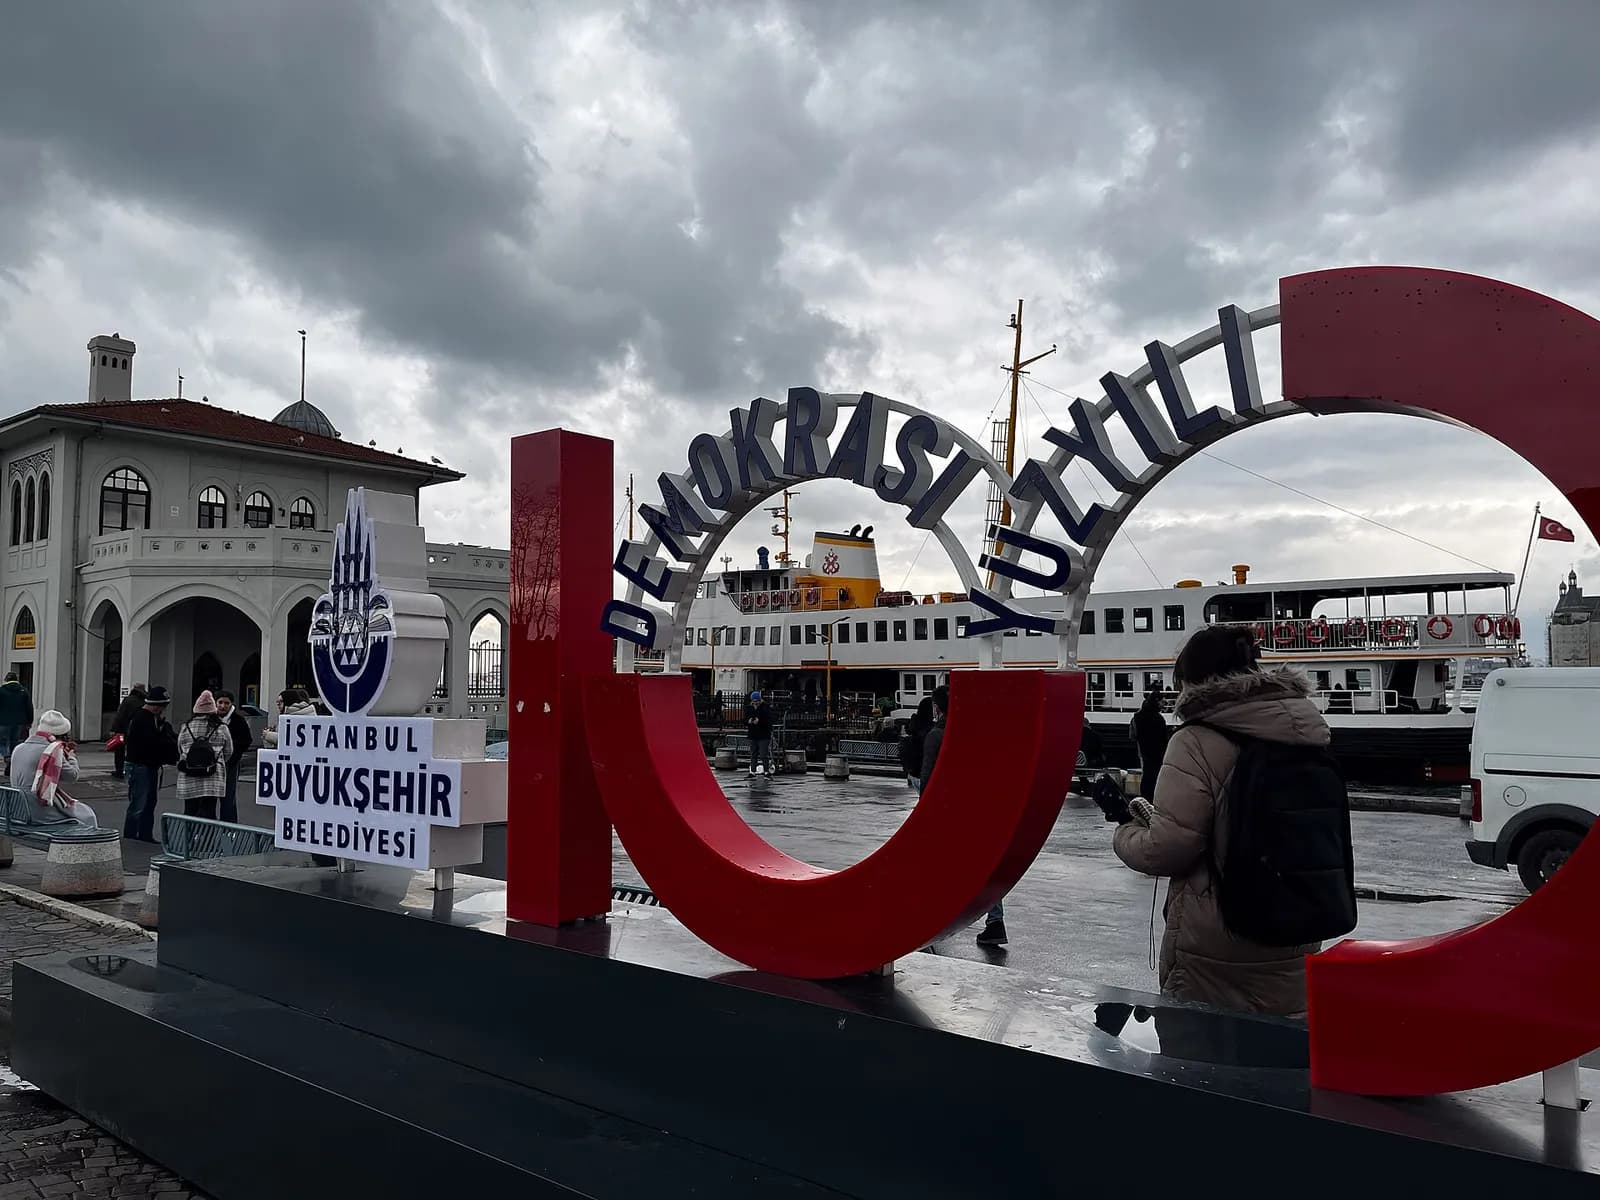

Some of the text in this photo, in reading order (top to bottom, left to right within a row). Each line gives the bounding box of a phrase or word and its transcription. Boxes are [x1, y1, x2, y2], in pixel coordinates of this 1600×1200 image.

[285, 719, 418, 753] İSTANBUL
[258, 754, 452, 818] BÜYÜKŞEHİR
[282, 817, 416, 860] BELEDİYESİ
